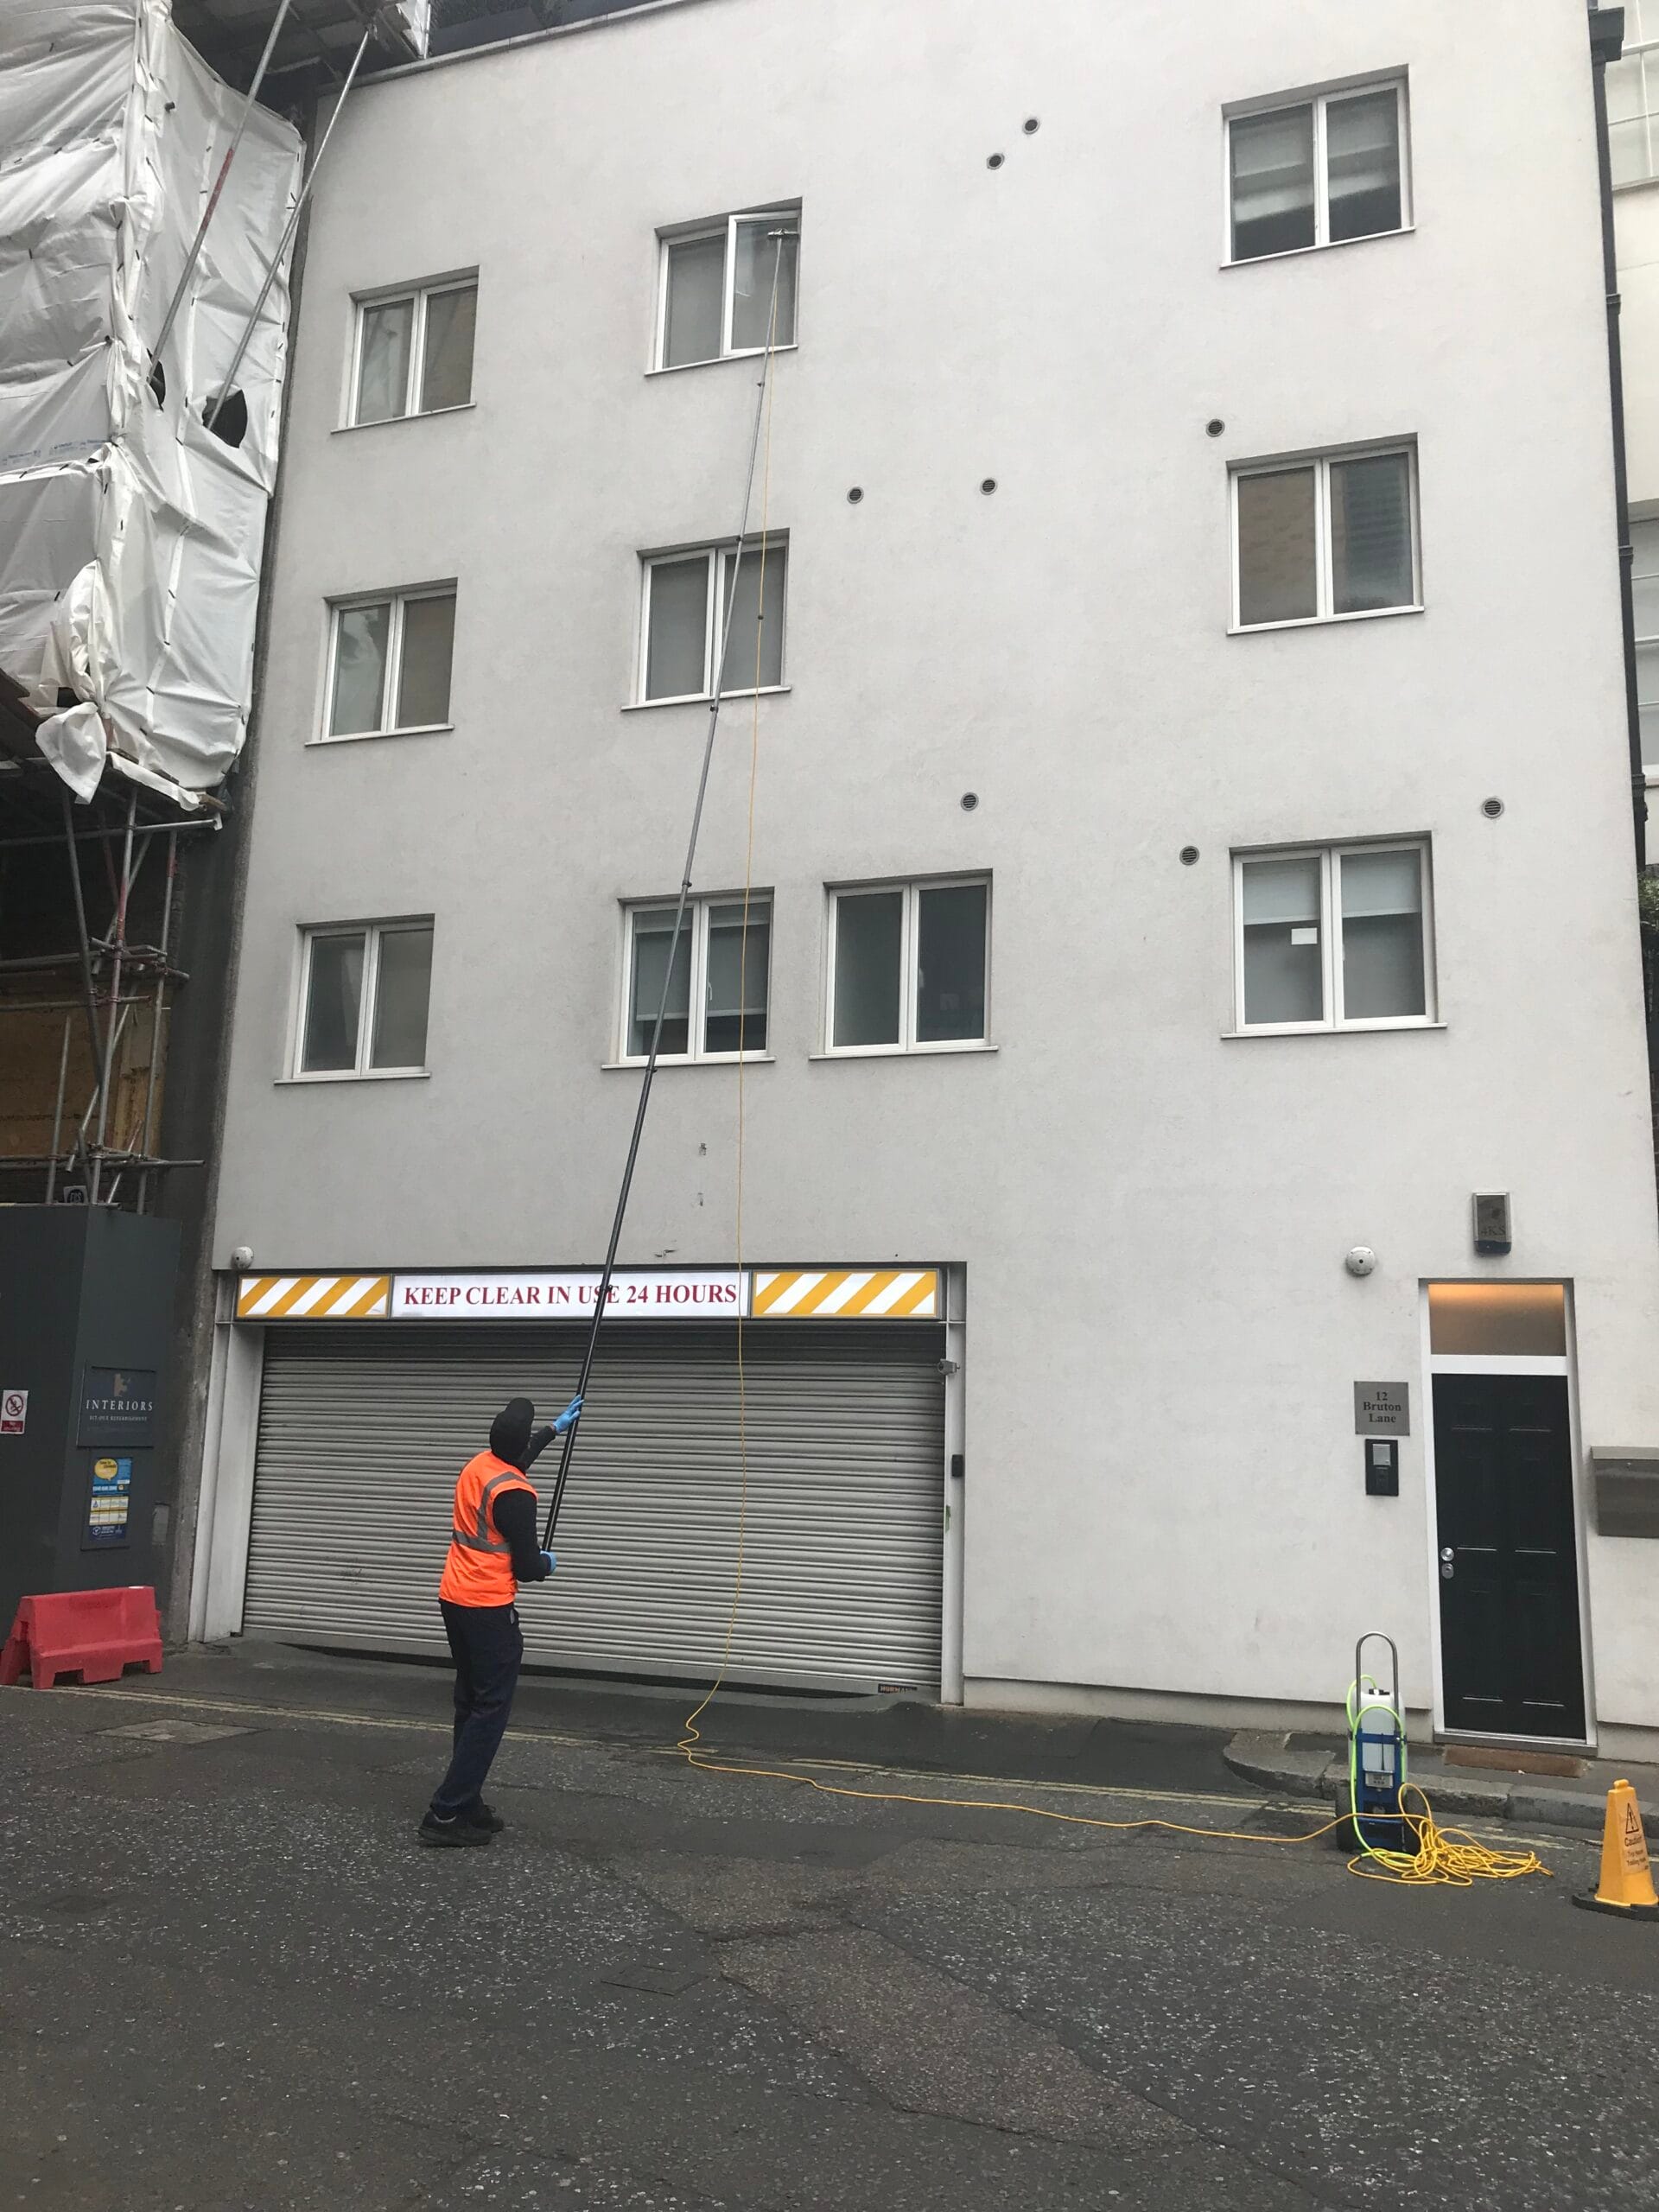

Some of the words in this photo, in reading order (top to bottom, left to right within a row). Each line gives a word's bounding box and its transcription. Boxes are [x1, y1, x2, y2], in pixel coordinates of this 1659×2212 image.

[404, 1287, 461, 1305] KEEP
[466, 1287, 541, 1305] CLEAR
[548, 1286, 571, 1304] IN
[626, 1285, 649, 1303] 24
[656, 1284, 737, 1303] HOURS
[1376, 1391, 1388, 1401] 12
[86, 1399, 153, 1411] INTERIORS
[1363, 1401, 1402, 1412] Bruton
[1369, 1413, 1396, 1423] Lane
